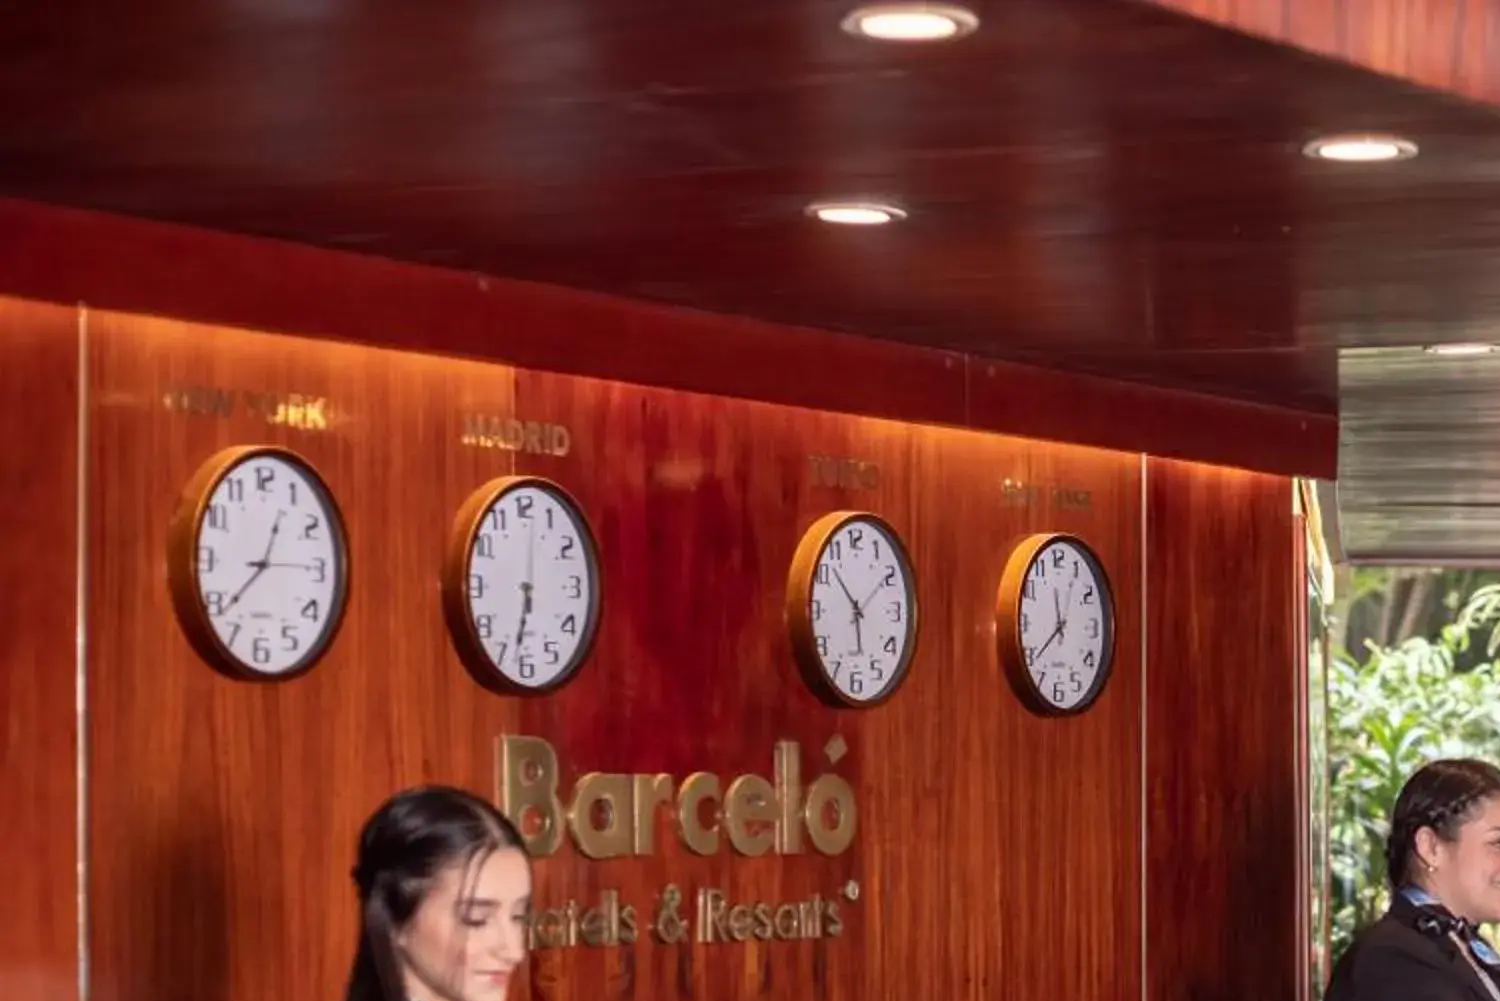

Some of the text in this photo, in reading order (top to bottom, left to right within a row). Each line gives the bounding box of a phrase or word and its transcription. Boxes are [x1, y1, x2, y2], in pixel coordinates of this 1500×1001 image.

[461, 413, 571, 457] MADRID
[227, 477, 244, 502] 11
[255, 466, 275, 493] 12
[288, 481, 297, 505] 1
[516, 495, 534, 519] 12
[545, 508, 554, 530] 1
[304, 514, 320, 540] 2
[490, 508, 506, 531] 11
[560, 535, 575, 560] 2
[830, 540, 841, 560] 11
[848, 529, 863, 550] 12
[872, 540, 879, 560] 1
[311, 557, 326, 583] 3
[885, 565, 896, 586] 2
[1035, 559, 1045, 577] 11
[1073, 561, 1079, 578] 1
[566, 575, 581, 599] 3
[300, 599, 319, 623] 4
[889, 601, 901, 623] 3
[226, 622, 242, 648] 7
[476, 614, 493, 638] 8
[560, 614, 576, 637] 4
[1088, 618, 1099, 639] 3
[252, 637, 270, 664] 6
[281, 626, 299, 651] 5
[883, 636, 897, 656] 4
[495, 641, 508, 666] 7
[543, 641, 560, 665] 5
[1083, 651, 1094, 668] 4
[518, 654, 535, 679] 6
[830, 661, 841, 681] 7
[870, 659, 883, 681] 5
[850, 672, 863, 694] 6
[1053, 681, 1066, 702] 6
[1069, 672, 1082, 692] 5
[494, 734, 857, 859] Barceló
[527, 888, 639, 950] otels
[657, 882, 689, 944] &
